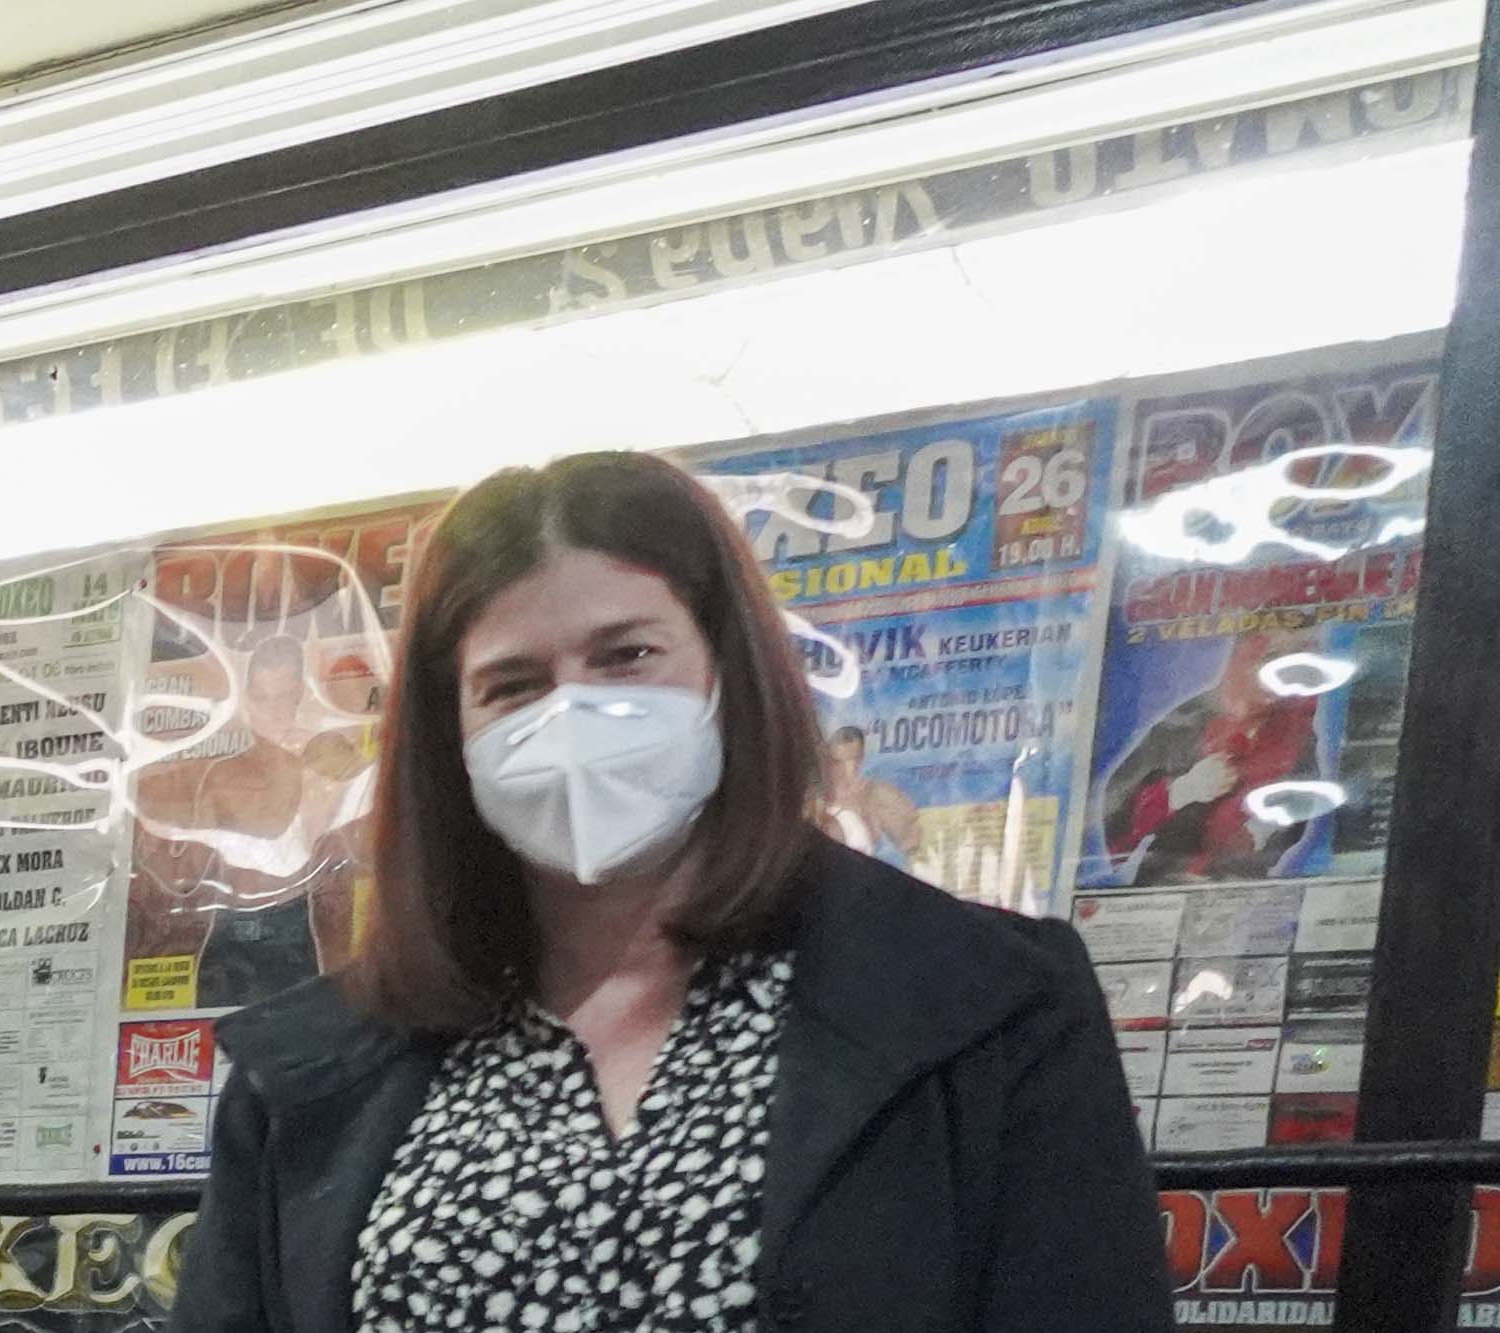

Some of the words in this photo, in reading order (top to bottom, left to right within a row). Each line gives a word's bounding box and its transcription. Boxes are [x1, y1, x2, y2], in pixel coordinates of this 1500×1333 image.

[1000, 448, 1088, 515] 26
[938, 623, 1072, 656] KEUKERIAN
[16, 731, 104, 759] IBOUNE
[16, 849, 63, 872] MORA
[23, 921, 90, 946] LACRUZ
[128, 1025, 201, 1082] CHARLIE
